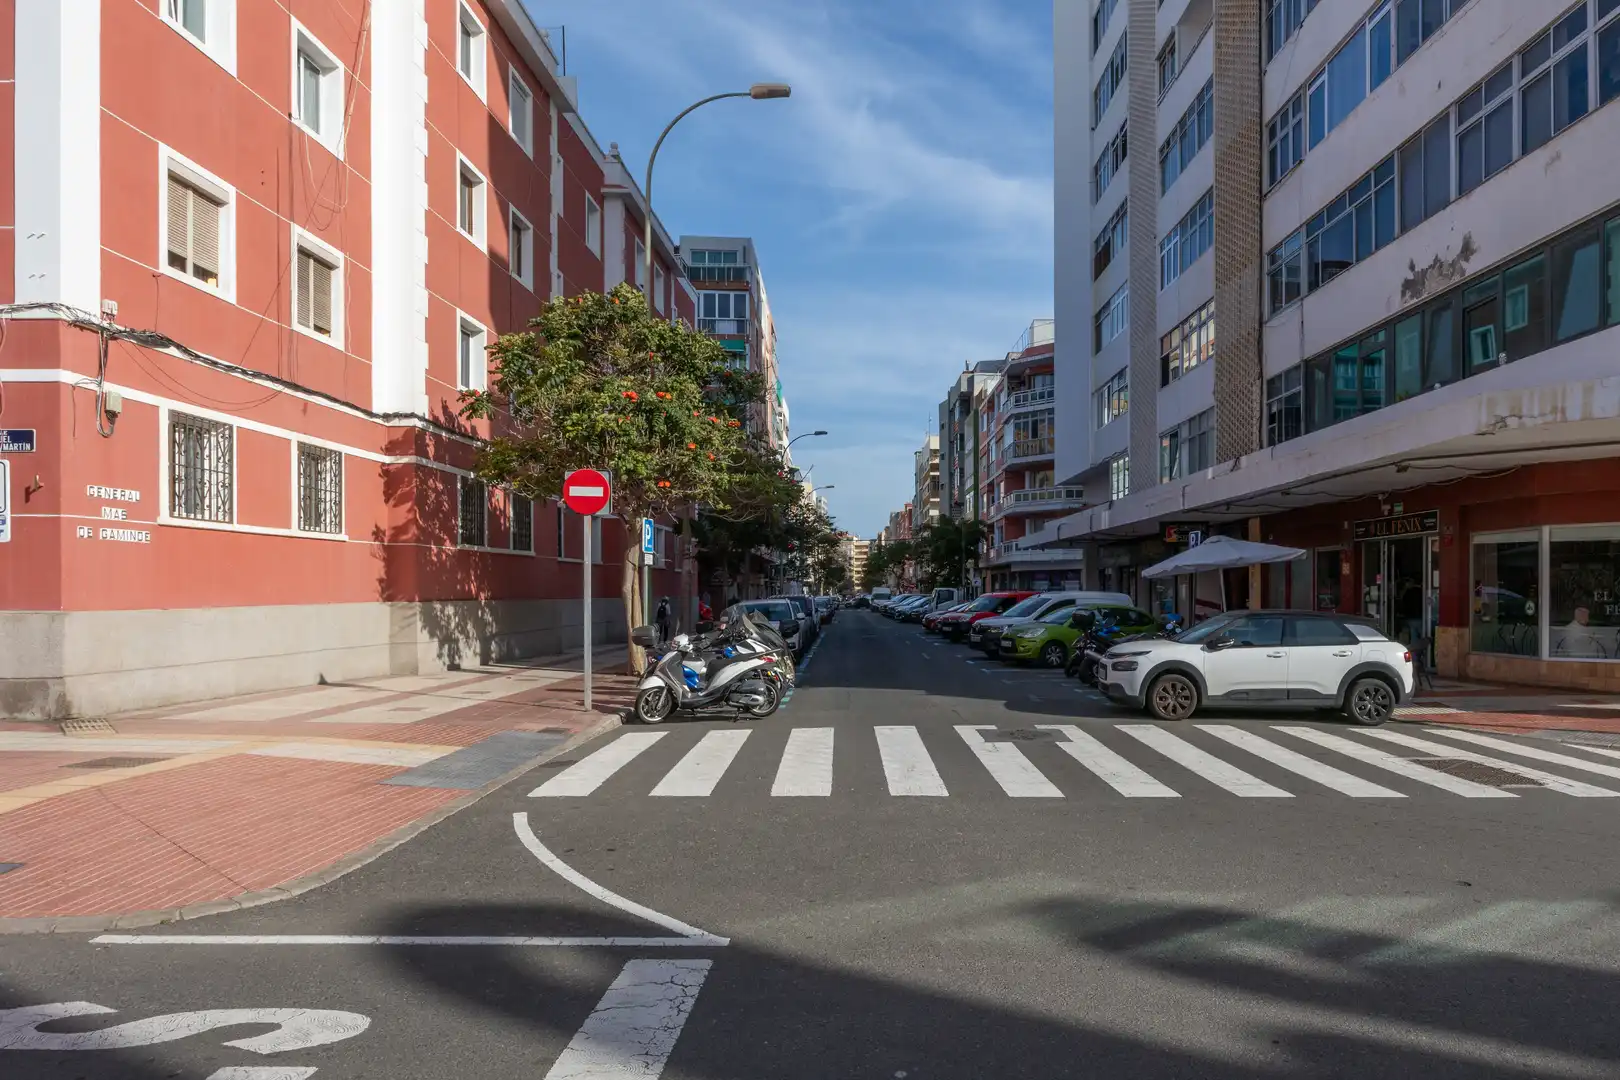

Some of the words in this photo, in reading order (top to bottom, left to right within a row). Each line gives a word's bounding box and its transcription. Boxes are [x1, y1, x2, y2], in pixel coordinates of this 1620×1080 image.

[88, 486, 140, 502] GENERAL
[103, 507, 127, 520] MAS
[78, 526, 93, 538] DE
[101, 528, 150, 542] GAMINDE
[645, 524, 651, 547] P
